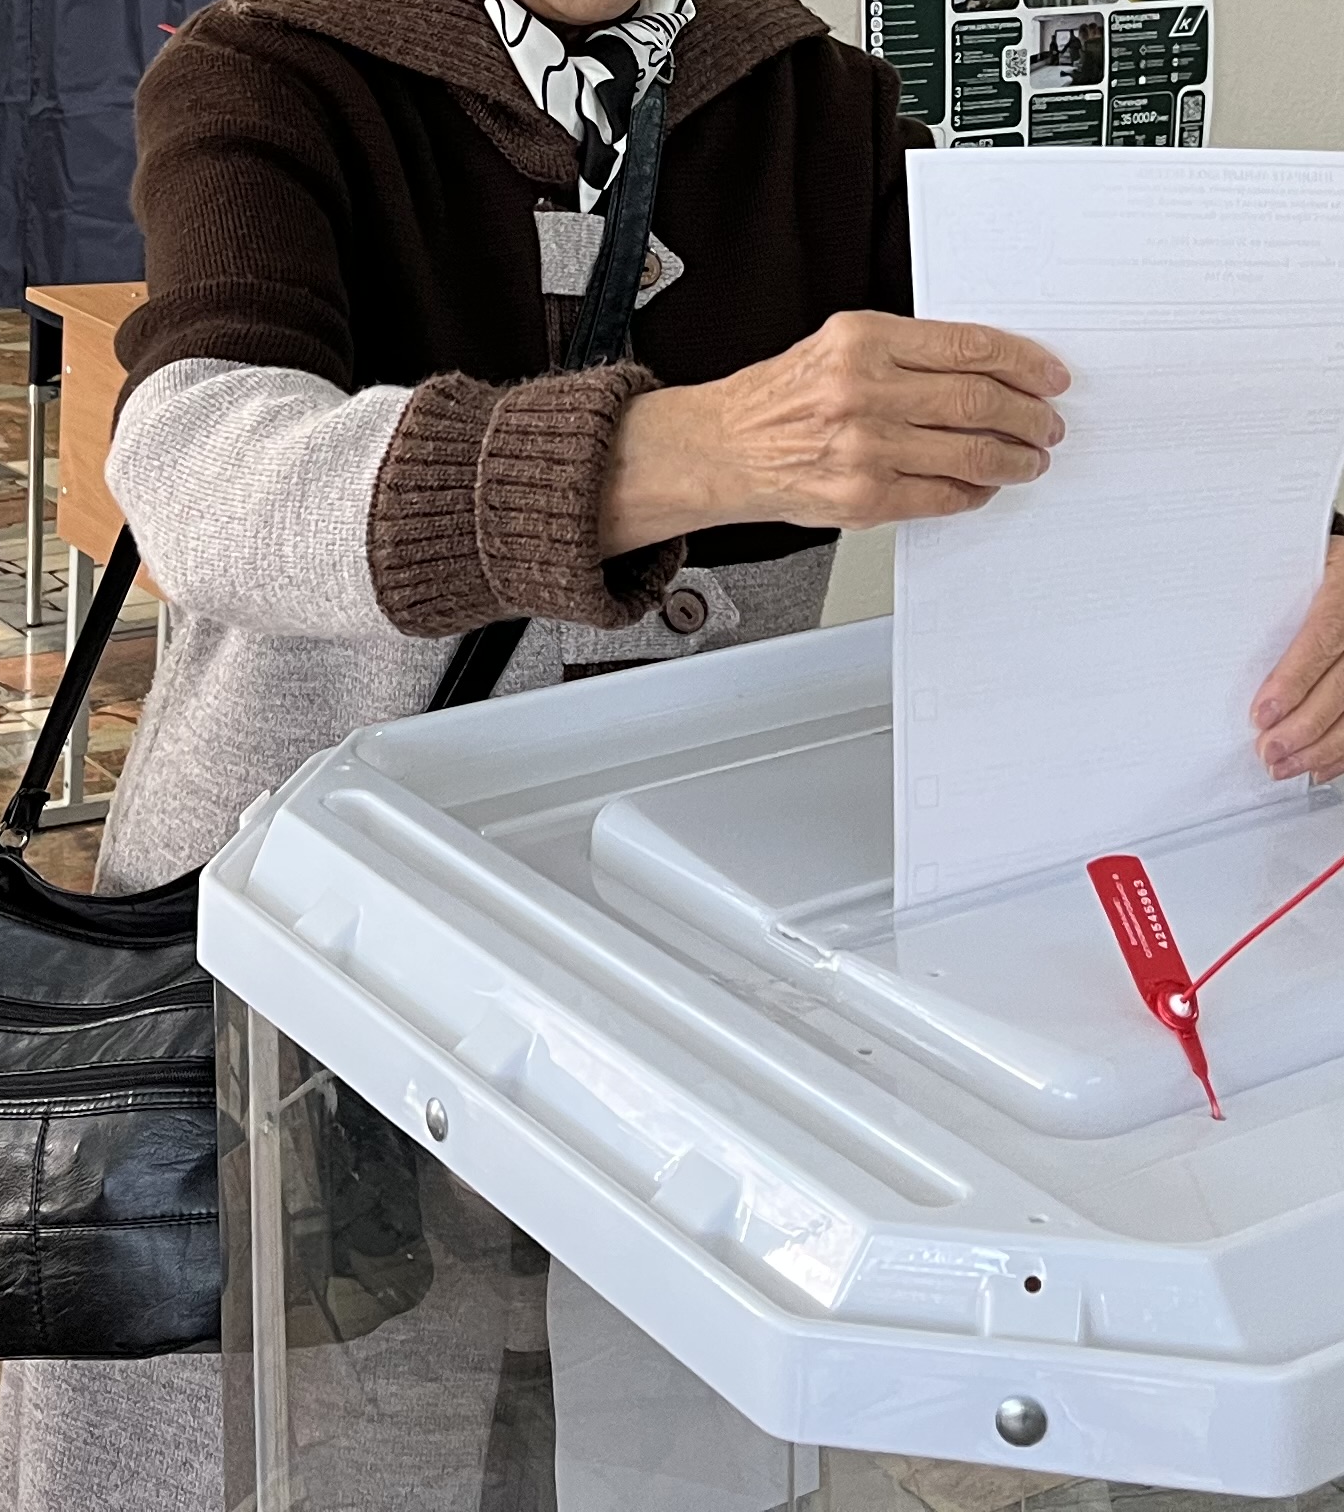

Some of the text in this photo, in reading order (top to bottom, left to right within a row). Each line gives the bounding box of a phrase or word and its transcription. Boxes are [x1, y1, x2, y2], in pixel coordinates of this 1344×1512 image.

[955, 35, 961, 46] 1
[954, 52, 962, 64] 2
[954, 87, 962, 98] 3
[954, 102, 961, 112] 4
[954, 115, 961, 126] 5
